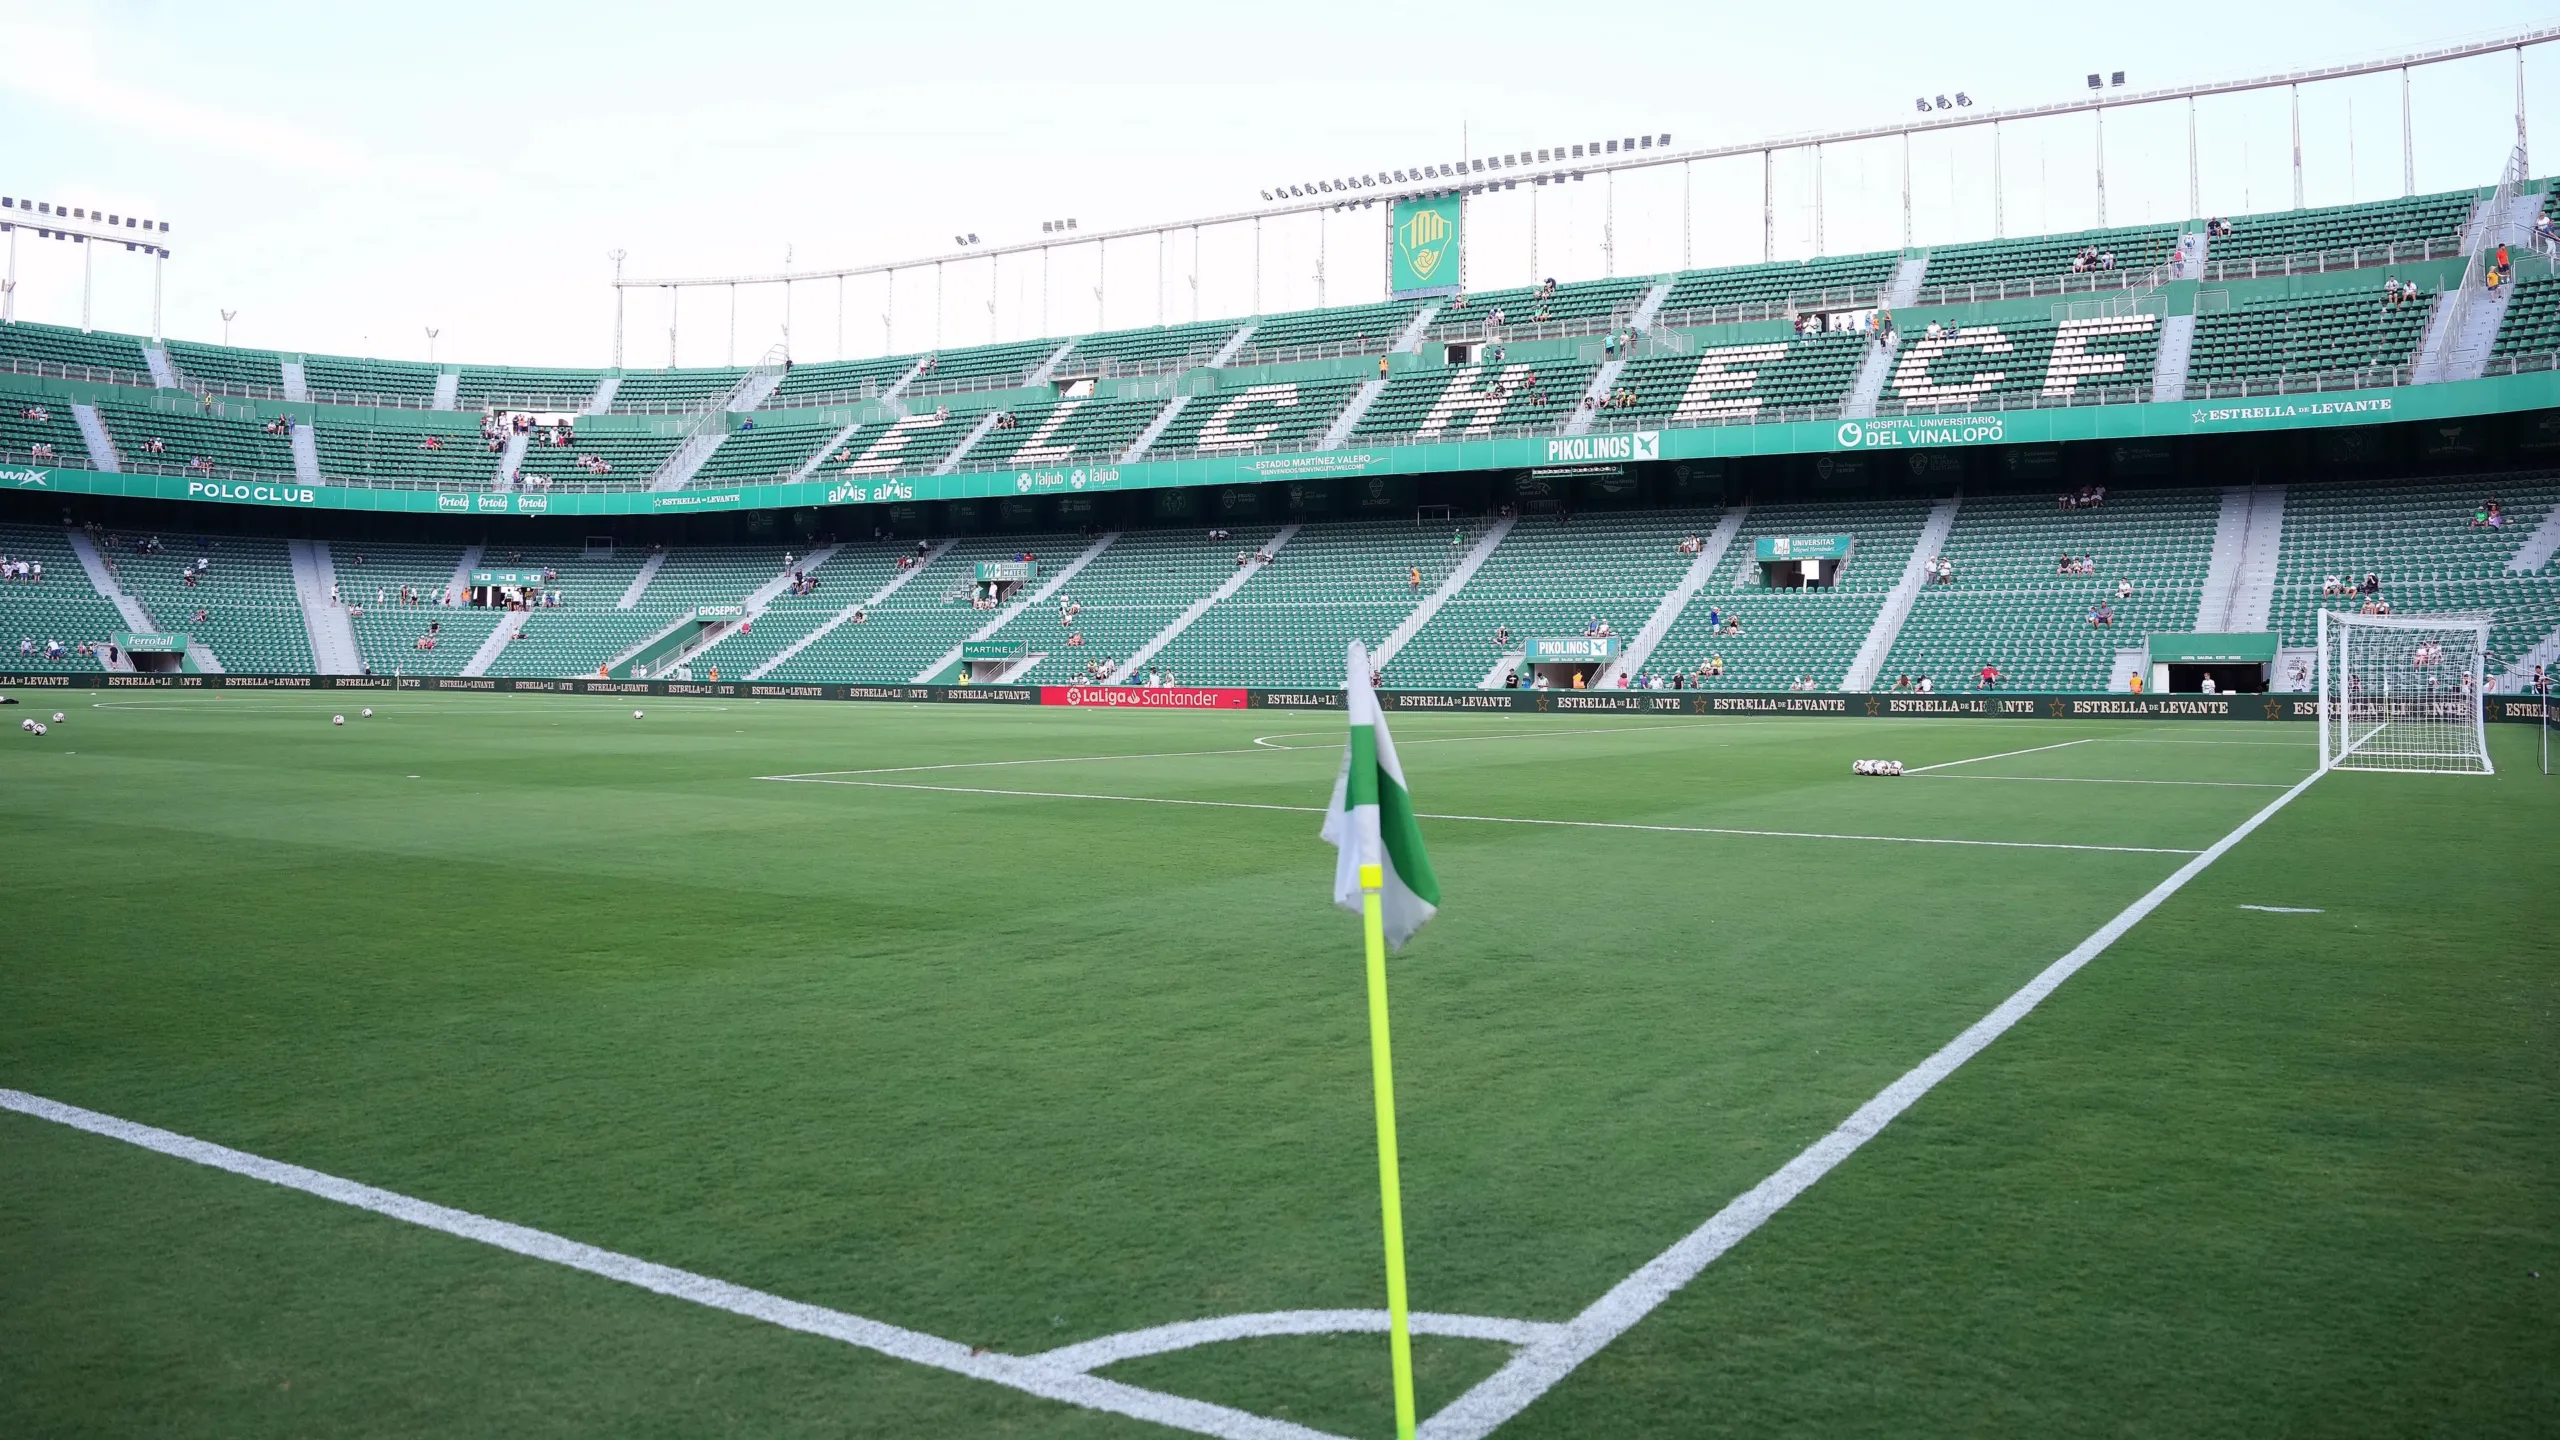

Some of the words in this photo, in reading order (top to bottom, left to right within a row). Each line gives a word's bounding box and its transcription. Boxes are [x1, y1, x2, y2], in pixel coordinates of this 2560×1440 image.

[2209, 406, 2296, 420] ESTRELLA
[2311, 399, 2392, 414] LEVANTE
[1865, 419, 1916, 430] HOSPITAL
[1920, 416, 1995, 427] UNIVERSITARIO
[1866, 431, 1902, 446] DEL
[1548, 436, 1630, 461] PIKOLINOS
[1255, 458, 1290, 469] ESTADIO
[1292, 455, 1335, 467] MARTÍNEZ
[1338, 454, 1371, 464] VALERO
[189, 482, 250, 499] POLO
[253, 486, 314, 503] CLUB
[662, 497, 701, 505] ESTRELLA
[707, 494, 740, 503] LEVANTE
[698, 605, 743, 616] GIOSEPPO
[1539, 641, 1590, 655] PIKOLINOS
[24, 677, 69, 685] LEVANTE
[108, 677, 155, 685] ESTRELLA
[225, 678, 269, 686] ESTRELLA
[336, 679, 375, 687] ESTRELLA
[440, 680, 467, 688] ESTRELLA
[587, 683, 617, 692] ESTRELLA
[621, 684, 648, 692] LEVANTE
[668, 685, 700, 693] ESTRELLA
[752, 686, 785, 695] ESTRELLA
[790, 687, 822, 696] LEVANTE
[850, 688, 887, 697] ESTRELLA
[948, 690, 988, 699] ESTRELLA
[994, 690, 1030, 699] LEVANTE
[1083, 689, 1126, 705] LaLiga
[1142, 689, 1218, 706] Santander
[1268, 694, 1318, 704] ESTRELLA
[1400, 696, 1454, 706] ESTRELLA
[1462, 696, 1511, 707] LEVANTE
[1557, 697, 1617, 708] ESTRELLA
[1625, 698, 1680, 709] LANTE
[1714, 699, 1777, 709] ESTRELLA
[1787, 699, 1845, 711] LEVANTE
[1890, 700, 1959, 712] ESTRELLA
[1970, 700, 2034, 712] LANTE
[2073, 701, 2149, 713] ESTRELLA
[2160, 701, 2228, 714] LEVANTE
